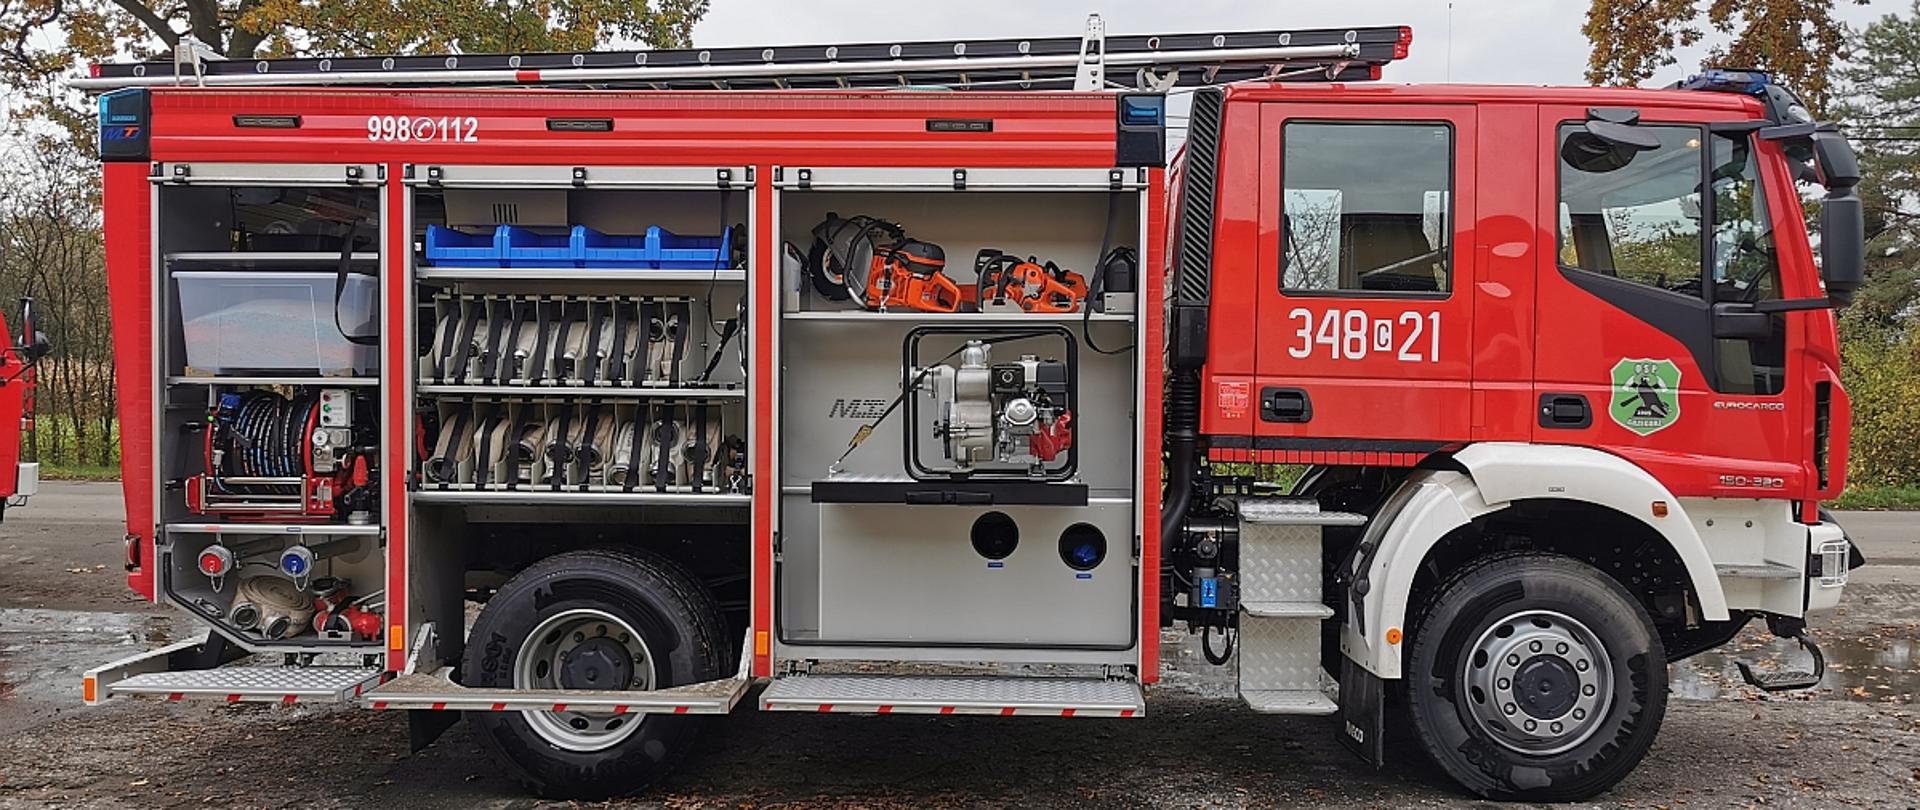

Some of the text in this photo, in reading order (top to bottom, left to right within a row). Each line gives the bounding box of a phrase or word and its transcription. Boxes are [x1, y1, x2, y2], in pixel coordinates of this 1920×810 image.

[367, 115, 478, 142] 998 112
[1288, 307, 1441, 363] 348 C 21
[1634, 362, 1658, 375] OSP
[1713, 401, 1785, 411] EUROCARGO
[1719, 475, 1784, 488] 150-320
